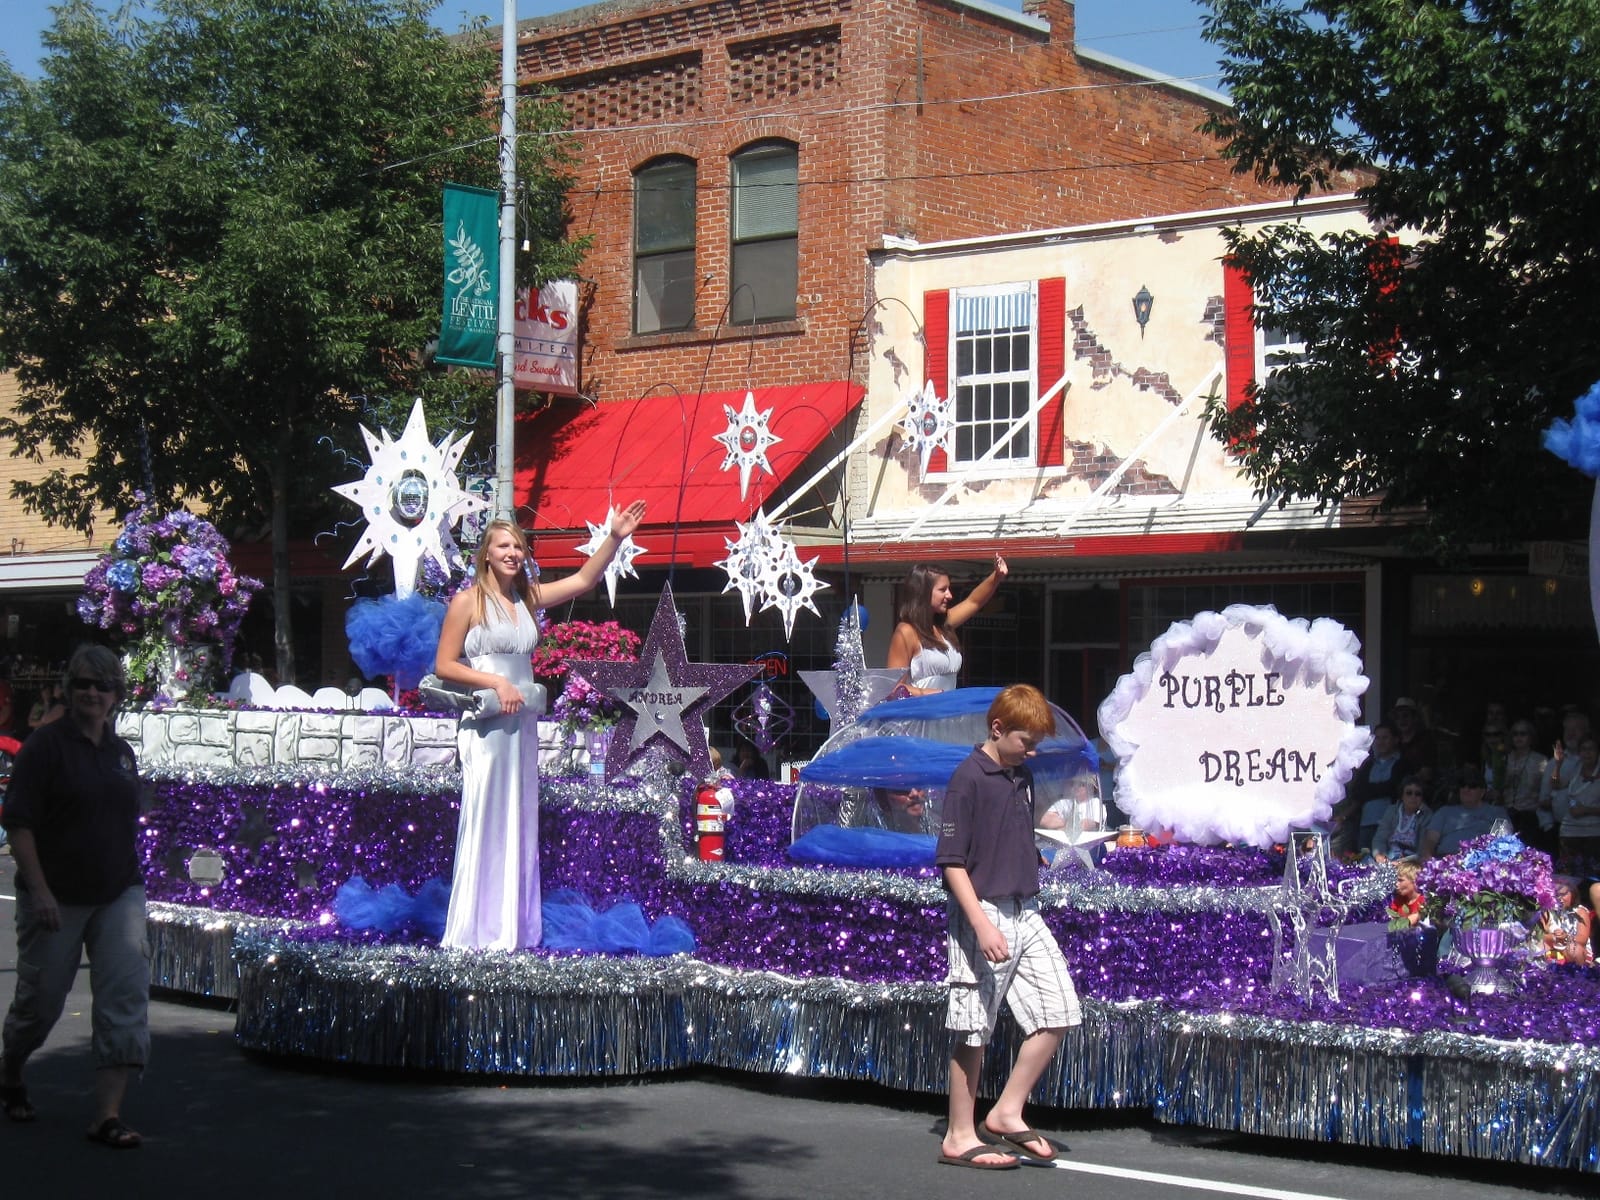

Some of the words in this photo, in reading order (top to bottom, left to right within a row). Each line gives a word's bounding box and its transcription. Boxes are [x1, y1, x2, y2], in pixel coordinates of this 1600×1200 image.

[450, 297, 497, 321] LENTIL
[515, 287, 568, 330] cks
[449, 316, 496, 329] FESTIVAL
[515, 340, 568, 354] MITED
[514, 360, 528, 373] nd
[530, 361, 562, 376] Sweets
[628, 690, 683, 706] ANDREA
[1159, 669, 1285, 713] PURPLE
[1199, 748, 1321, 787] DREAM
